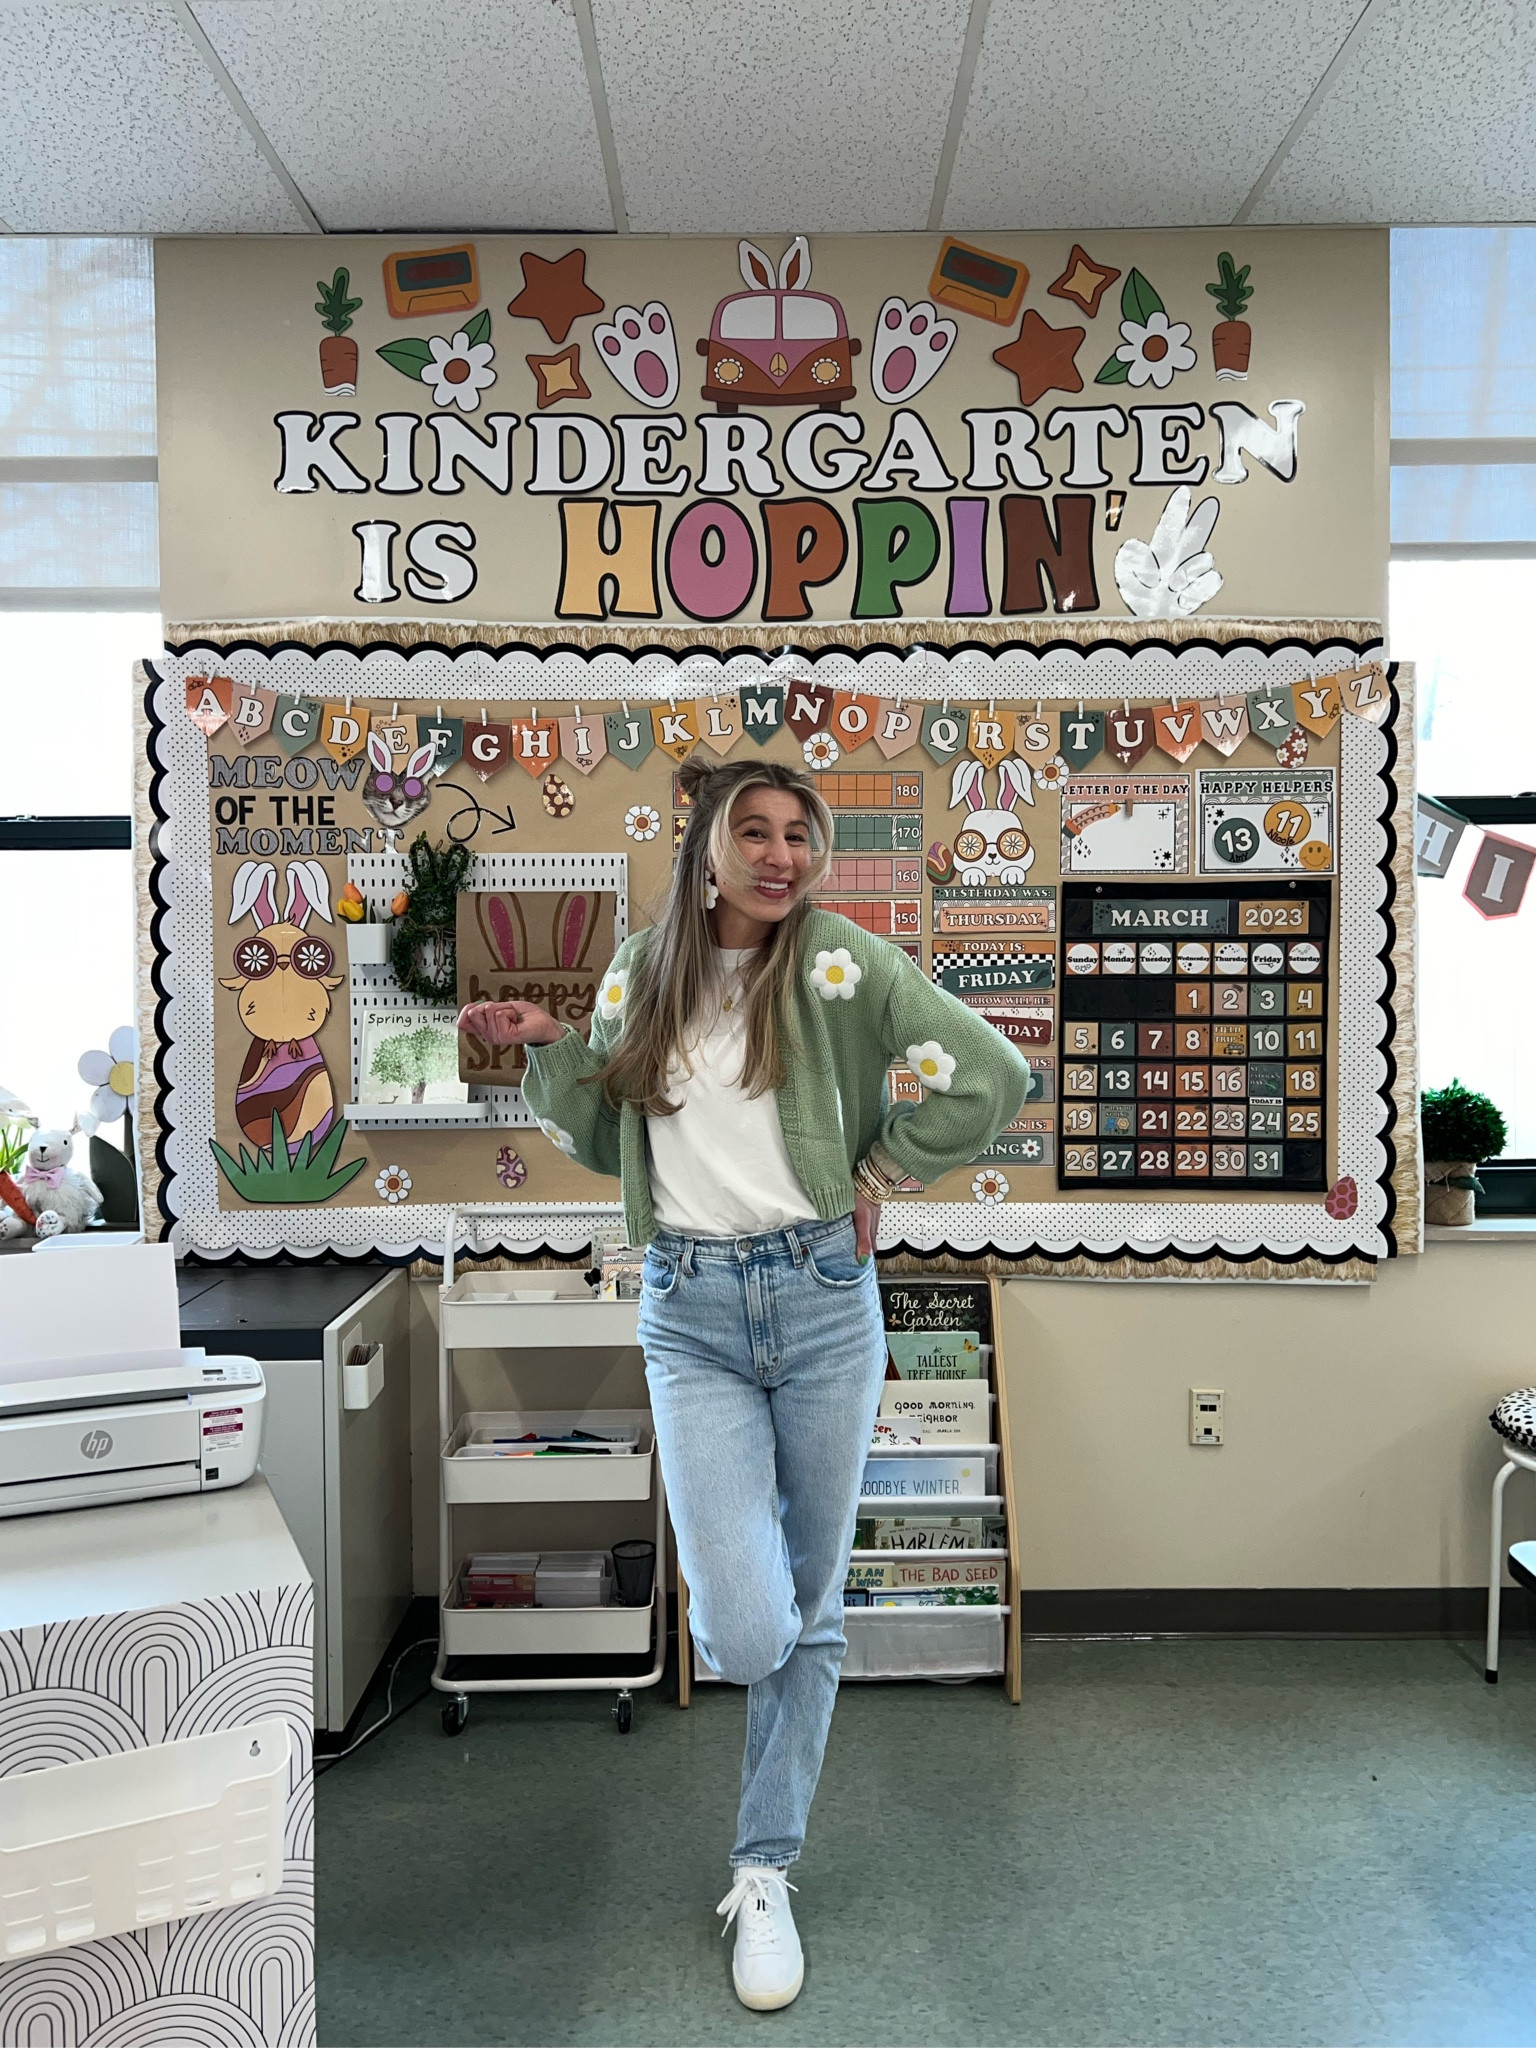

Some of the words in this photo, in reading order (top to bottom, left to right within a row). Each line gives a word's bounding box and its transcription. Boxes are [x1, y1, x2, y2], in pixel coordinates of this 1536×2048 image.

[273, 399, 1306, 496] KINDERGARTEN
[352, 518, 478, 604] IS
[554, 489, 1128, 621] HOPPIN'
[196, 689, 224, 716] A
[235, 697, 263, 727] B
[281, 708, 310, 738] C
[328, 716, 360, 745] D
[382, 727, 410, 754] E
[428, 728, 452, 755] F
[472, 733, 501, 761] G
[520, 729, 551, 758] H
[573, 727, 592, 756] I
[618, 721, 641, 750] J
[659, 714, 693, 745] K
[706, 708, 733, 736] L
[744, 697, 778, 725] M
[791, 693, 825, 725] N
[838, 705, 868, 733] O
[881, 711, 911, 739] P
[928, 718, 959, 753] Q
[974, 720, 1005, 750] R
[1024, 722, 1051, 751] S
[1066, 722, 1097, 750] T
[1113, 719, 1146, 748] U
[1161, 713, 1194, 743] V
[1203, 707, 1245, 738] W
[1255, 699, 1290, 730] X
[1300, 688, 1333, 719] Y
[1349, 674, 1382, 708] Z
[208, 755, 365, 790] MEOW
[895, 785, 919, 797] 180
[1062, 785, 1111, 796] LETTER
[1114, 784, 1128, 795] OF
[1133, 784, 1160, 795] THE
[1163, 783, 1190, 796] DAY
[1200, 781, 1258, 795] HAPPY
[1262, 780, 1334, 794] HELPERS
[215, 795, 256, 826] OF
[268, 795, 336, 826] THE
[896, 827, 920, 838] 170
[1277, 809, 1304, 839] 11
[216, 827, 405, 856] MOMENT
[1221, 827, 1253, 853] 13
[895, 870, 919, 882] 160
[943, 889, 1019, 898] YESTERDAY
[1022, 888, 1051, 897] WAS:
[895, 912, 917, 924] 150
[946, 913, 1042, 926] THURSDAY
[1111, 909, 1209, 927] MARCH
[1244, 908, 1303, 926] 2023
[962, 942, 1007, 951] TODAY
[1009, 942, 1026, 951] IS:
[1067, 956, 1099, 964] Sunday
[1254, 955, 1282, 963] Friday
[958, 970, 1036, 988] FRIDAY
[1187, 989, 1198, 1010] 1
[1221, 988, 1239, 1010] 2
[1259, 988, 1275, 1010] 3
[1297, 989, 1314, 1009] 4
[368, 1013, 412, 1026] Spring
[417, 1013, 429, 1024] is
[432, 1013, 457, 1024] Her
[1074, 1028, 1088, 1049] 5
[1110, 1029, 1126, 1050] 6
[1148, 1029, 1163, 1050] 7
[1185, 1029, 1200, 1050] 8
[1253, 1030, 1280, 1051] 10
[1294, 1028, 1317, 1050] 11
[896, 1082, 917, 1094] 110
[1067, 1069, 1095, 1091] 12
[1104, 1069, 1131, 1091] 13
[1142, 1070, 1168, 1091] 14
[1180, 1071, 1205, 1092] 15
[1216, 1070, 1242, 1092] 16
[1290, 1070, 1317, 1091] 18
[1030, 1121, 1047, 1130] IS:
[1067, 1109, 1093, 1131] 19
[1141, 1109, 1168, 1131] 21
[1176, 1113, 1208, 1131] 22
[1213, 1110, 1245, 1131] 23
[1250, 1111, 1281, 1131] 24
[1289, 1112, 1319, 1133] 25
[1065, 1150, 1097, 1171] 26
[1102, 1150, 1133, 1171] 27
[1140, 1150, 1170, 1170] 28
[1177, 1150, 1208, 1171] 29
[1214, 1150, 1246, 1171] 30
[1252, 1151, 1279, 1171] 31
[889, 1291, 922, 1309] The
[926, 1291, 975, 1309] Secret
[902, 1309, 962, 1332] Garden
[917, 1355, 958, 1367] TALLEST
[907, 1369, 932, 1380] TREE
[935, 1369, 968, 1380] HOUSE
[84, 1430, 111, 1459] hp
[891, 1532, 966, 1549] HARLEM
[864, 1567, 885, 1578] AN
[899, 1569, 926, 1583] THE
[932, 1567, 960, 1582] BAD
[965, 1567, 998, 1582] SEED
[856, 1578, 883, 1588] WHO
